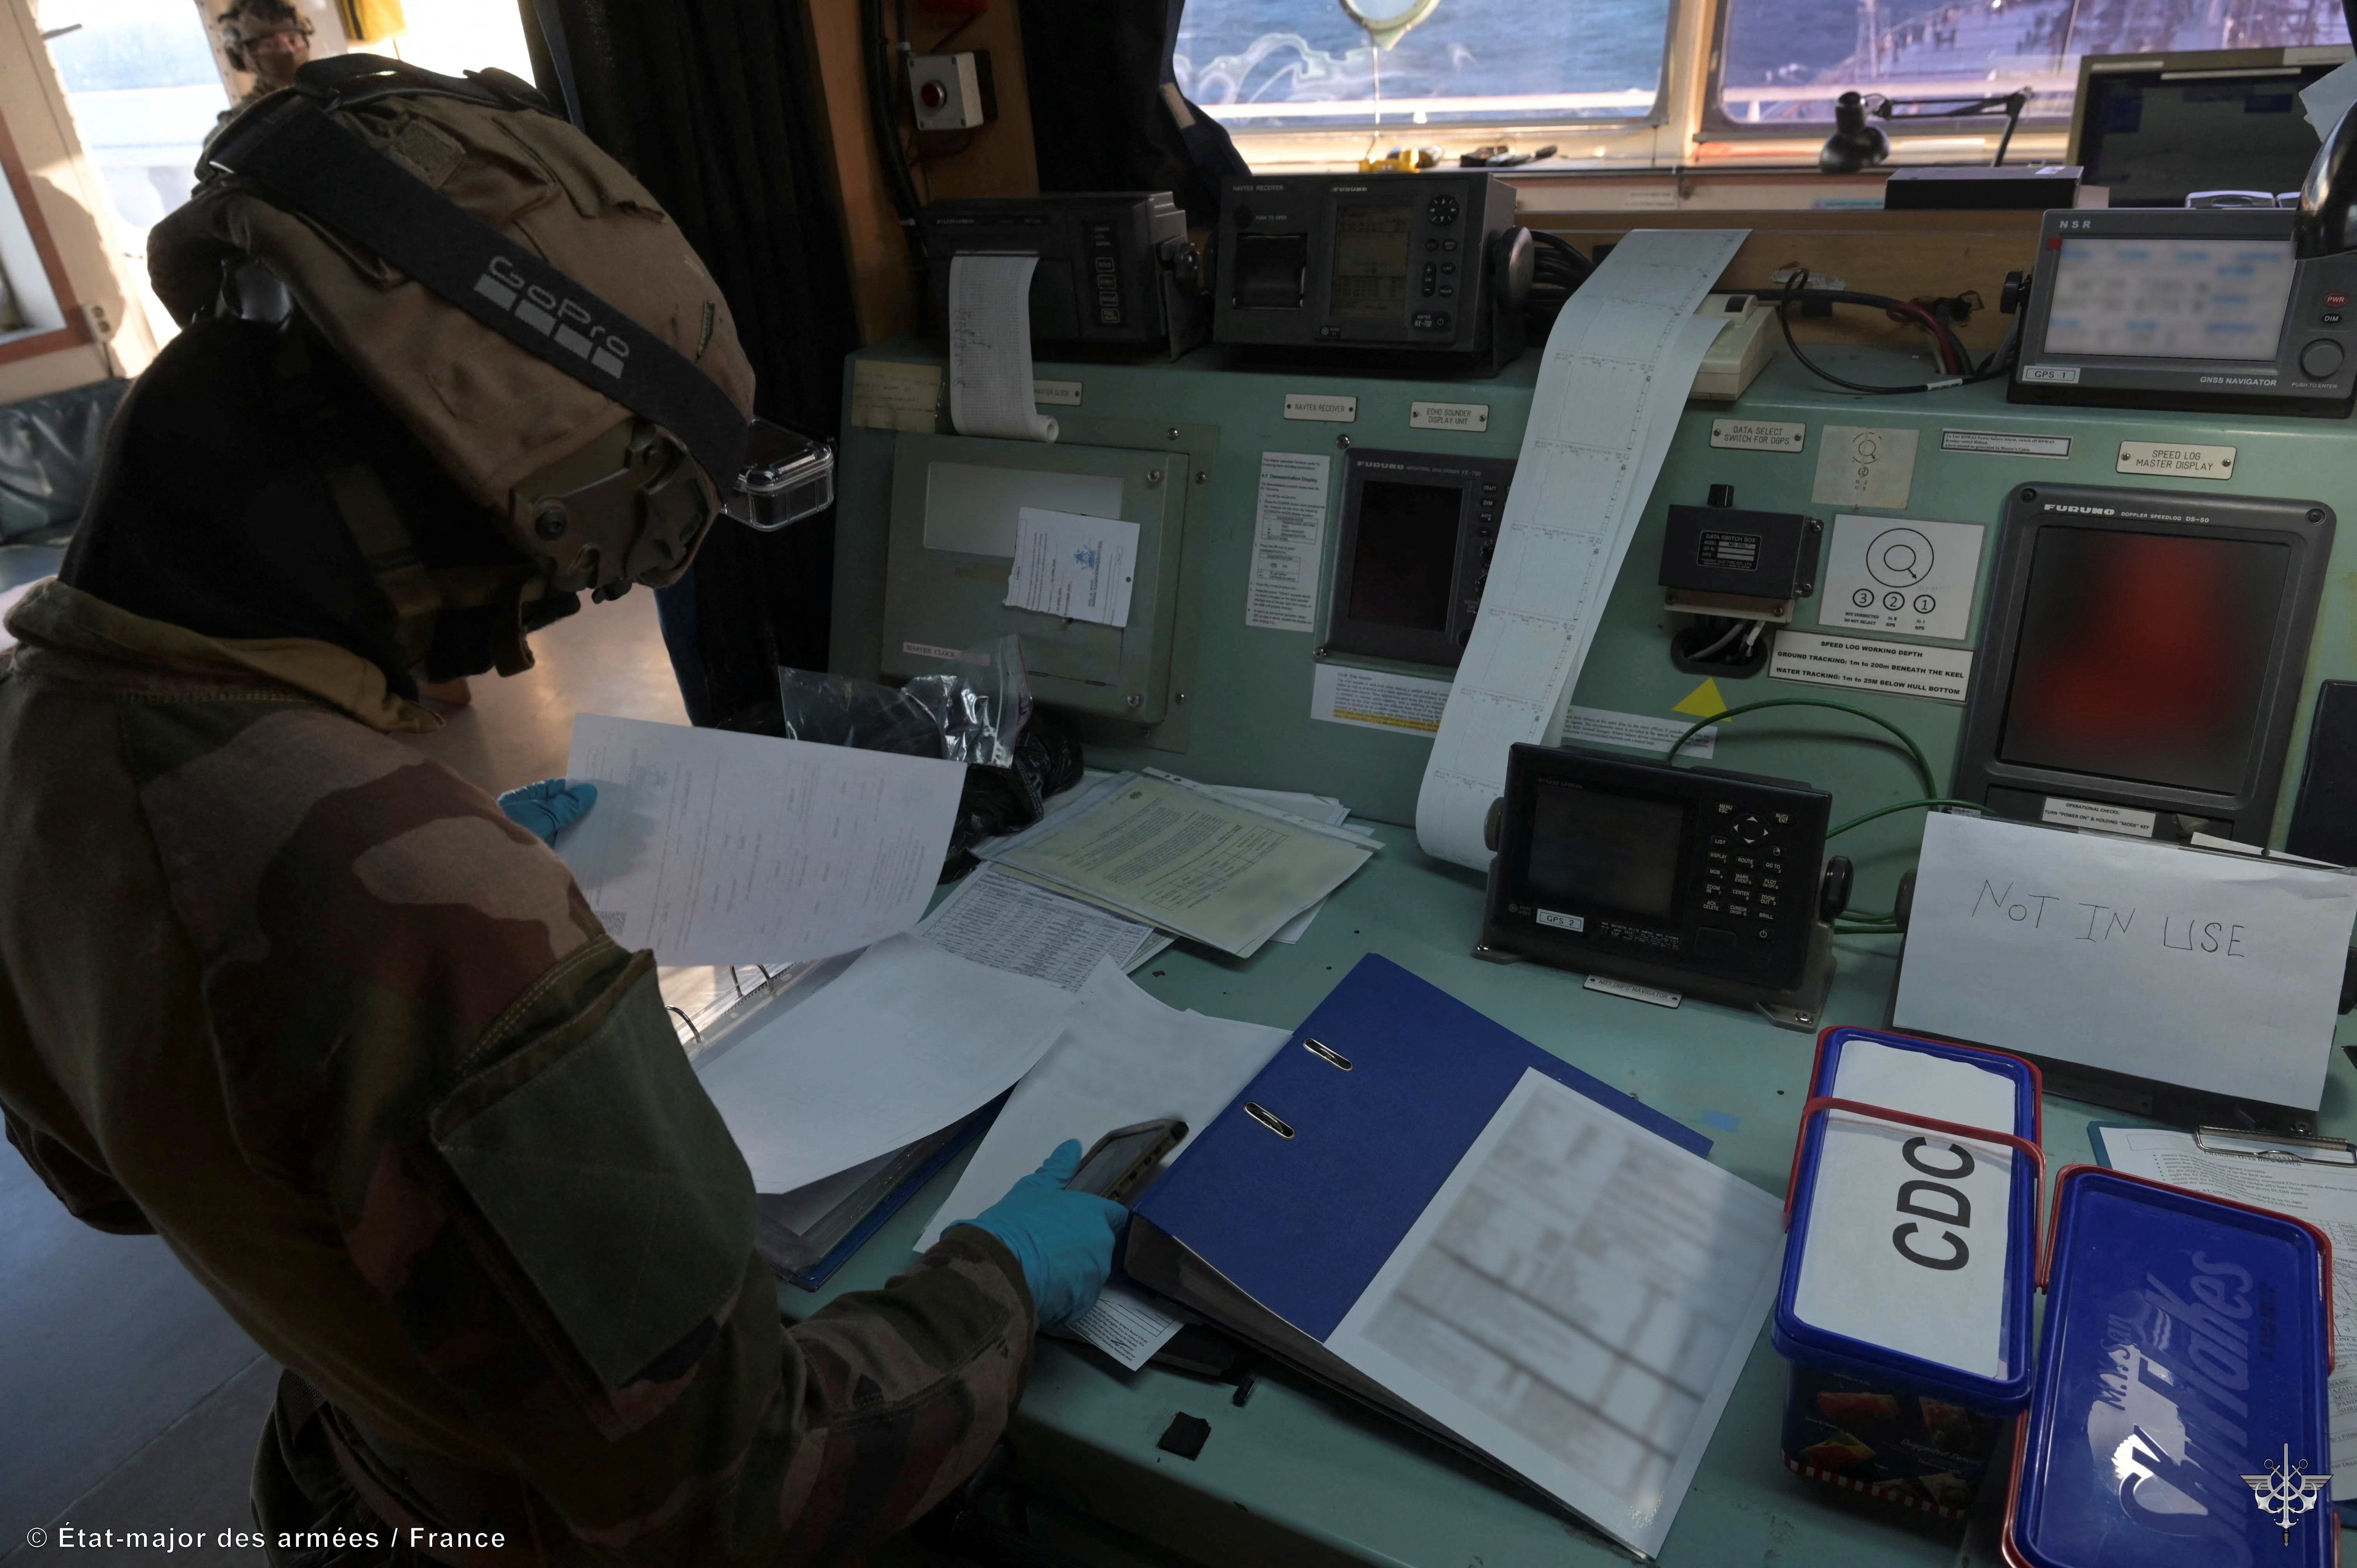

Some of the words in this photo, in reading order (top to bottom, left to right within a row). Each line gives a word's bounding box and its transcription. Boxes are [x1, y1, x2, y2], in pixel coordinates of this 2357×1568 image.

[487, 255, 630, 358] GoPro
[2226, 378, 2277, 386] NAVIGATOR
[1428, 415, 1453, 424] DISPLAY
[1756, 427, 1782, 435] SELECT
[1724, 434, 1751, 443] SWITCH
[2152, 450, 2180, 459] SPEED
[2184, 452, 2201, 460] LOG
[1357, 461, 1404, 470] FURUNO
[2136, 459, 2172, 468] MASTER
[2176, 461, 2213, 471] DISPLAY
[2044, 504, 2115, 515] FURUNO
[1859, 593, 1867, 604] 3
[1890, 597, 1897, 607] 2
[1921, 600, 1928, 610] 1
[906, 645, 931, 654] MASTER
[1862, 646, 1896, 655] WORKING
[1778, 651, 1807, 660] GROUND
[1809, 655, 1847, 664] TRACKING:
[1892, 665, 1926, 673] BENEATH
[1802, 670, 1840, 680] TRACKING:
[1929, 685, 1960, 695] BOTTOM
[2066, 803, 2099, 811] OPERATIONAL
[1547, 915, 1563, 924] GPS
[1972, 879, 2059, 928] NOT
[2075, 903, 2135, 942] IN
[2164, 916, 2244, 957] USE
[1632, 987, 1668, 999] NAVIGATOR
[1893, 1136, 1975, 1270] CDC
